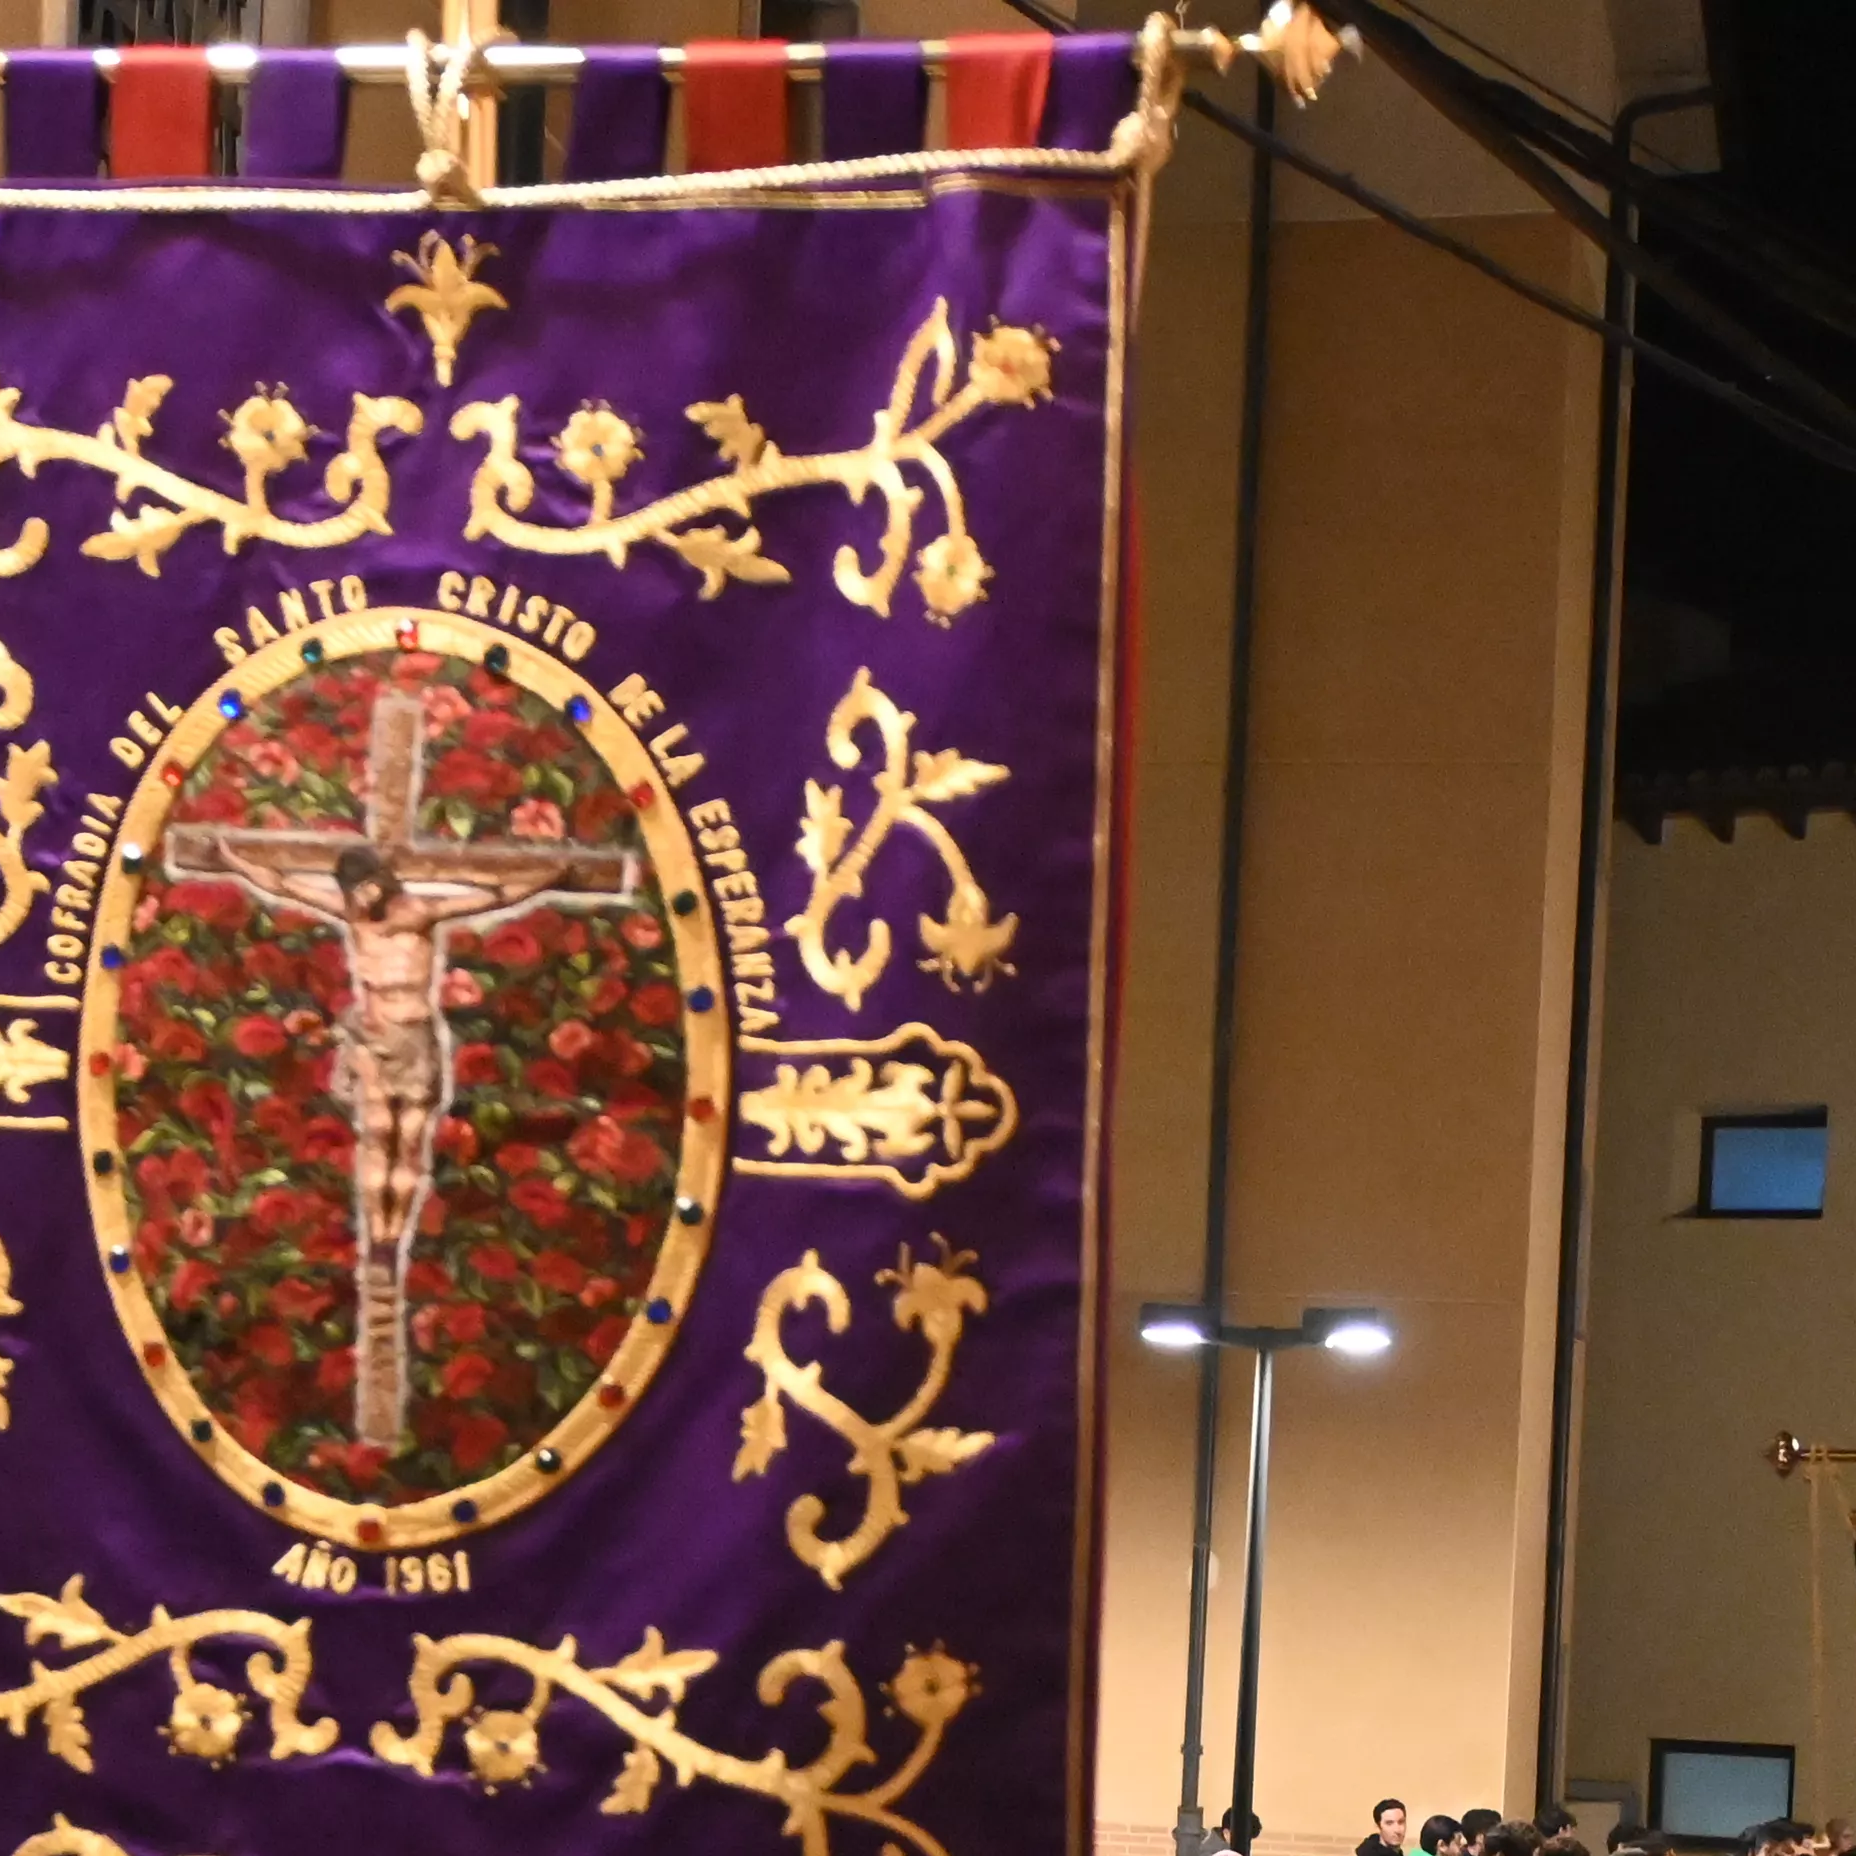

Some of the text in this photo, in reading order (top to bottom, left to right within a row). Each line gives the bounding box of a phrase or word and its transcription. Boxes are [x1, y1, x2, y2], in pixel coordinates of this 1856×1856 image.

[44, 570, 780, 1033] COFRADIA DEL SANTO CRISTO DE LA ESPERANZA
[271, 1540, 471, 1597] AÑO 1961
